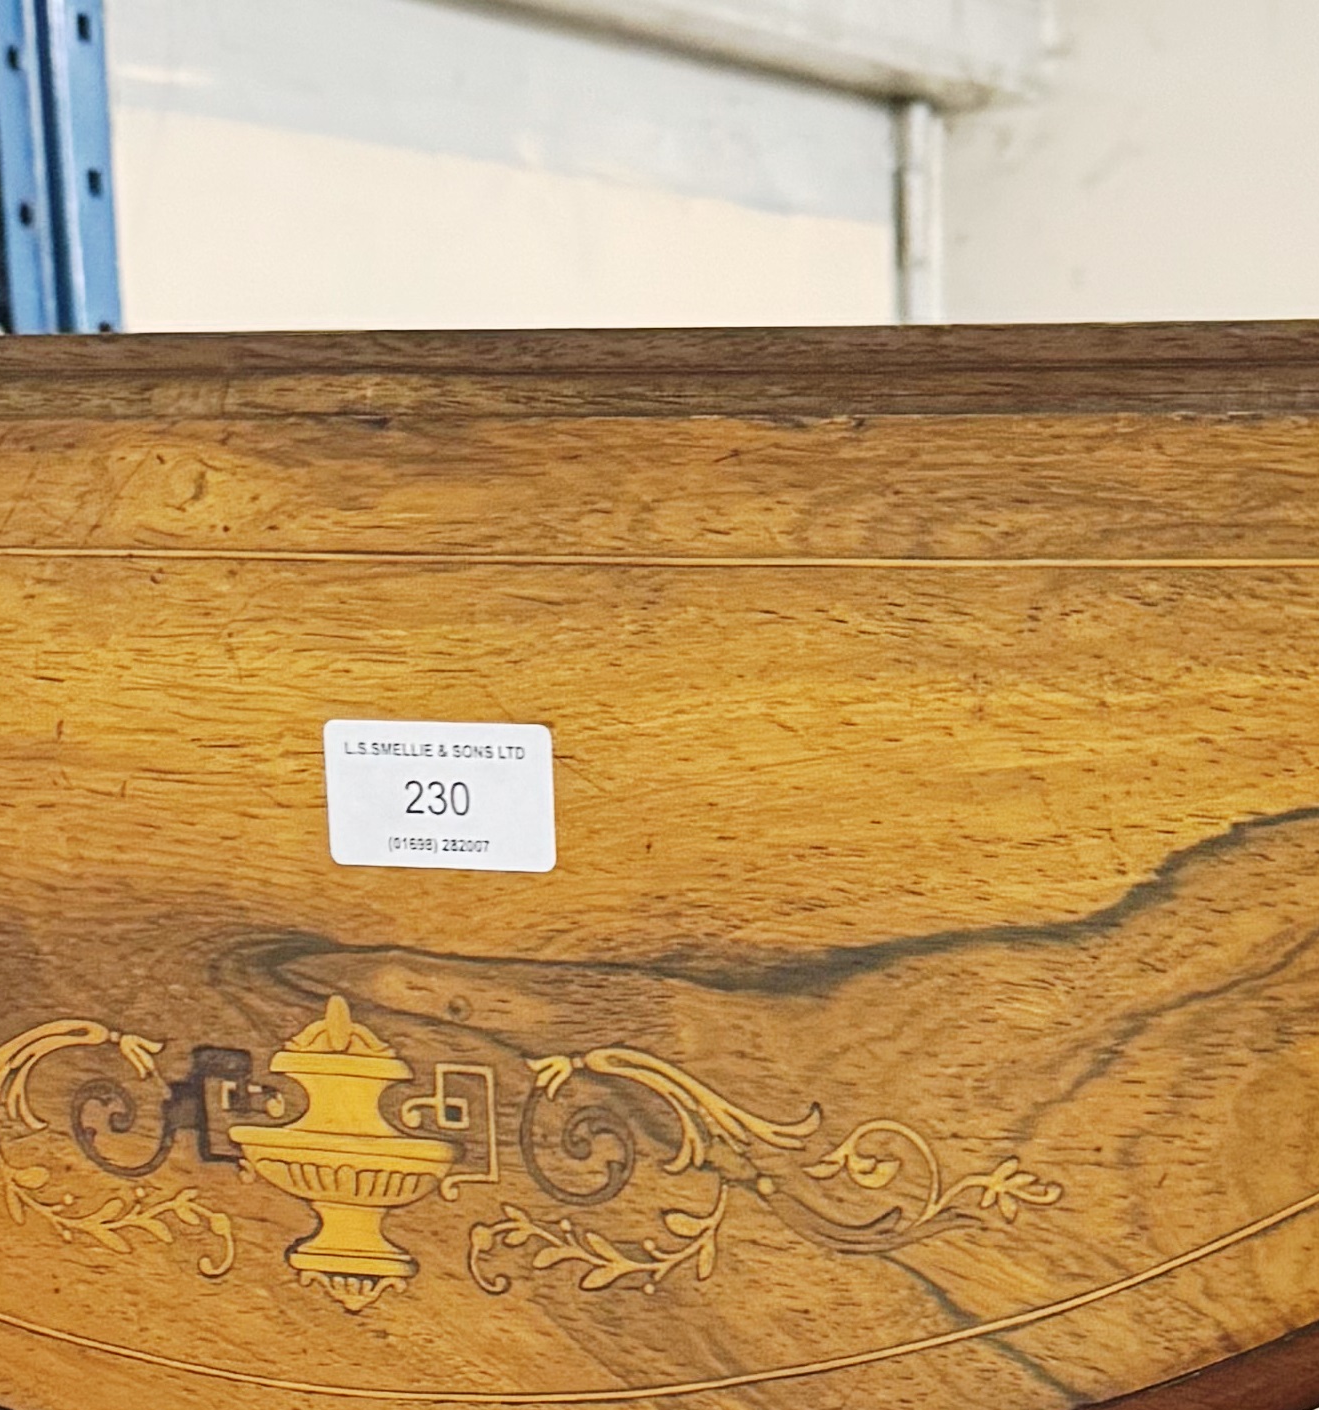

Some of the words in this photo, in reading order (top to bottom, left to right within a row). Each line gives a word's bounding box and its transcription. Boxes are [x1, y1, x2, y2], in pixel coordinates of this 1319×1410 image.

[438, 744, 448, 758] &
[452, 744, 494, 759] SONS
[498, 746, 526, 760] LTD
[404, 780, 470, 816] 230
[442, 838, 490, 853] 282007
